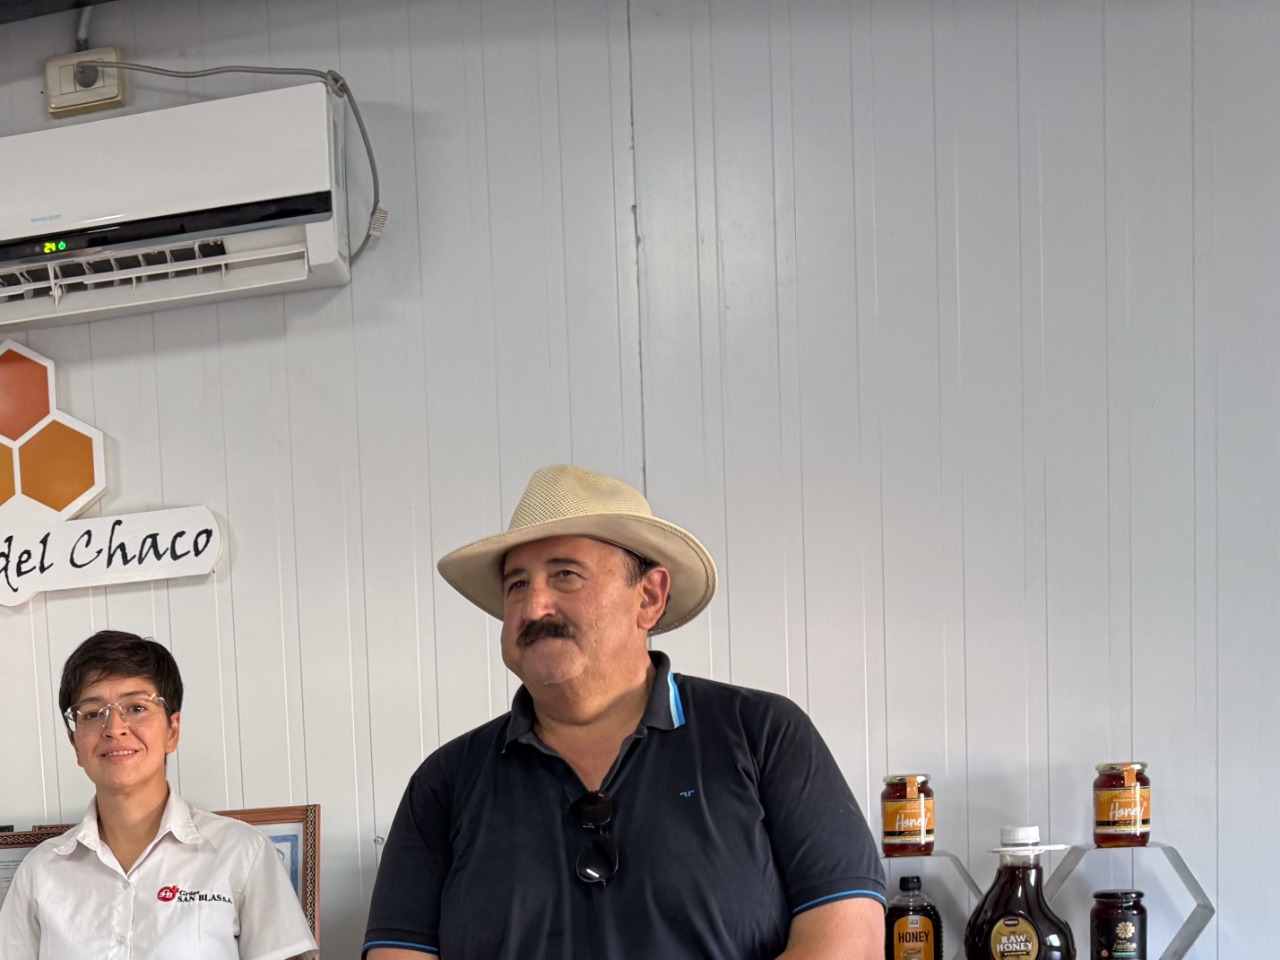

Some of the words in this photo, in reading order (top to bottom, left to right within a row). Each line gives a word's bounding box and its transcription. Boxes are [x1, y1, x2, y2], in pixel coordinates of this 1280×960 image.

[44, 242, 56, 253] 24
[69, 519, 213, 569] Chaco
[198, 894, 222, 902] BLAS
[898, 931, 930, 943] HONEY
[1001, 934, 1027, 944] RAW
[996, 941, 1033, 952] HONEY
